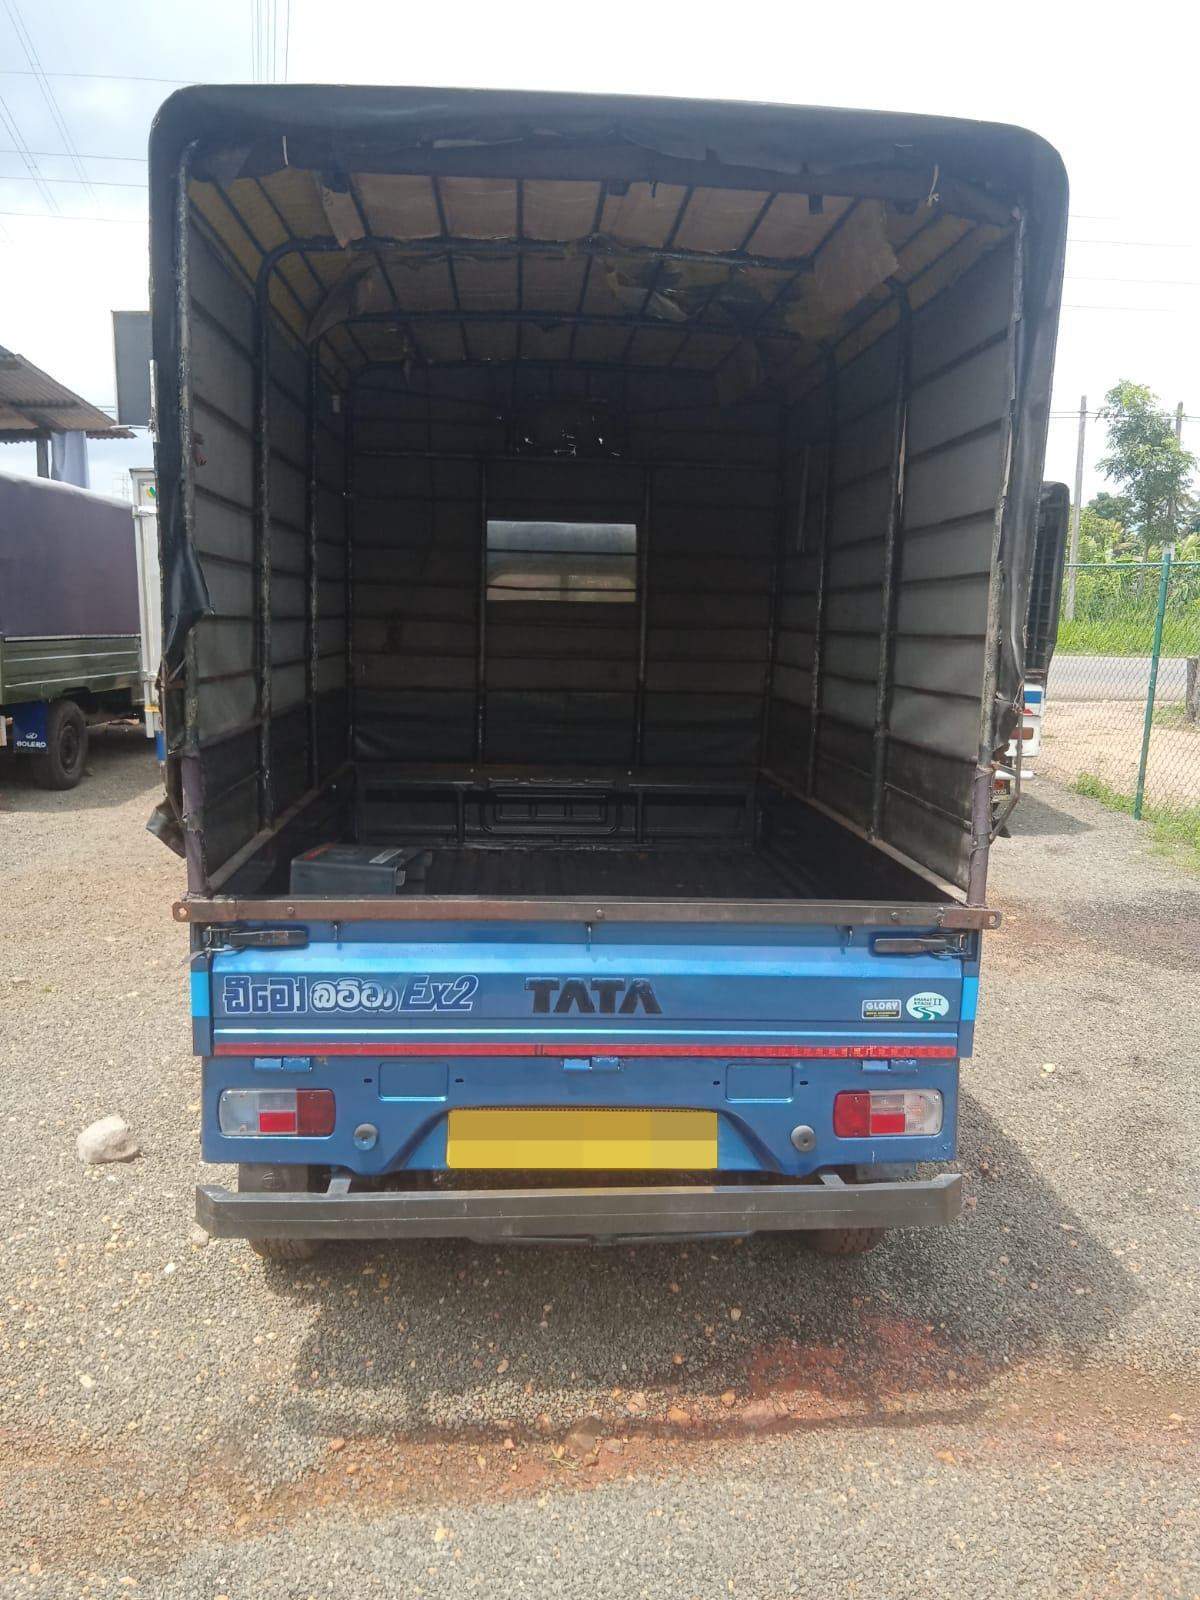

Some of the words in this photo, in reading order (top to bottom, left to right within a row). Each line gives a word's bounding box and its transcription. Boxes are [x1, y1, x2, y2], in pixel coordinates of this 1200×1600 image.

[399, 975, 479, 1012] Ex2
[525, 977, 662, 1014] TATA
[866, 1002, 898, 1010] GLORY
